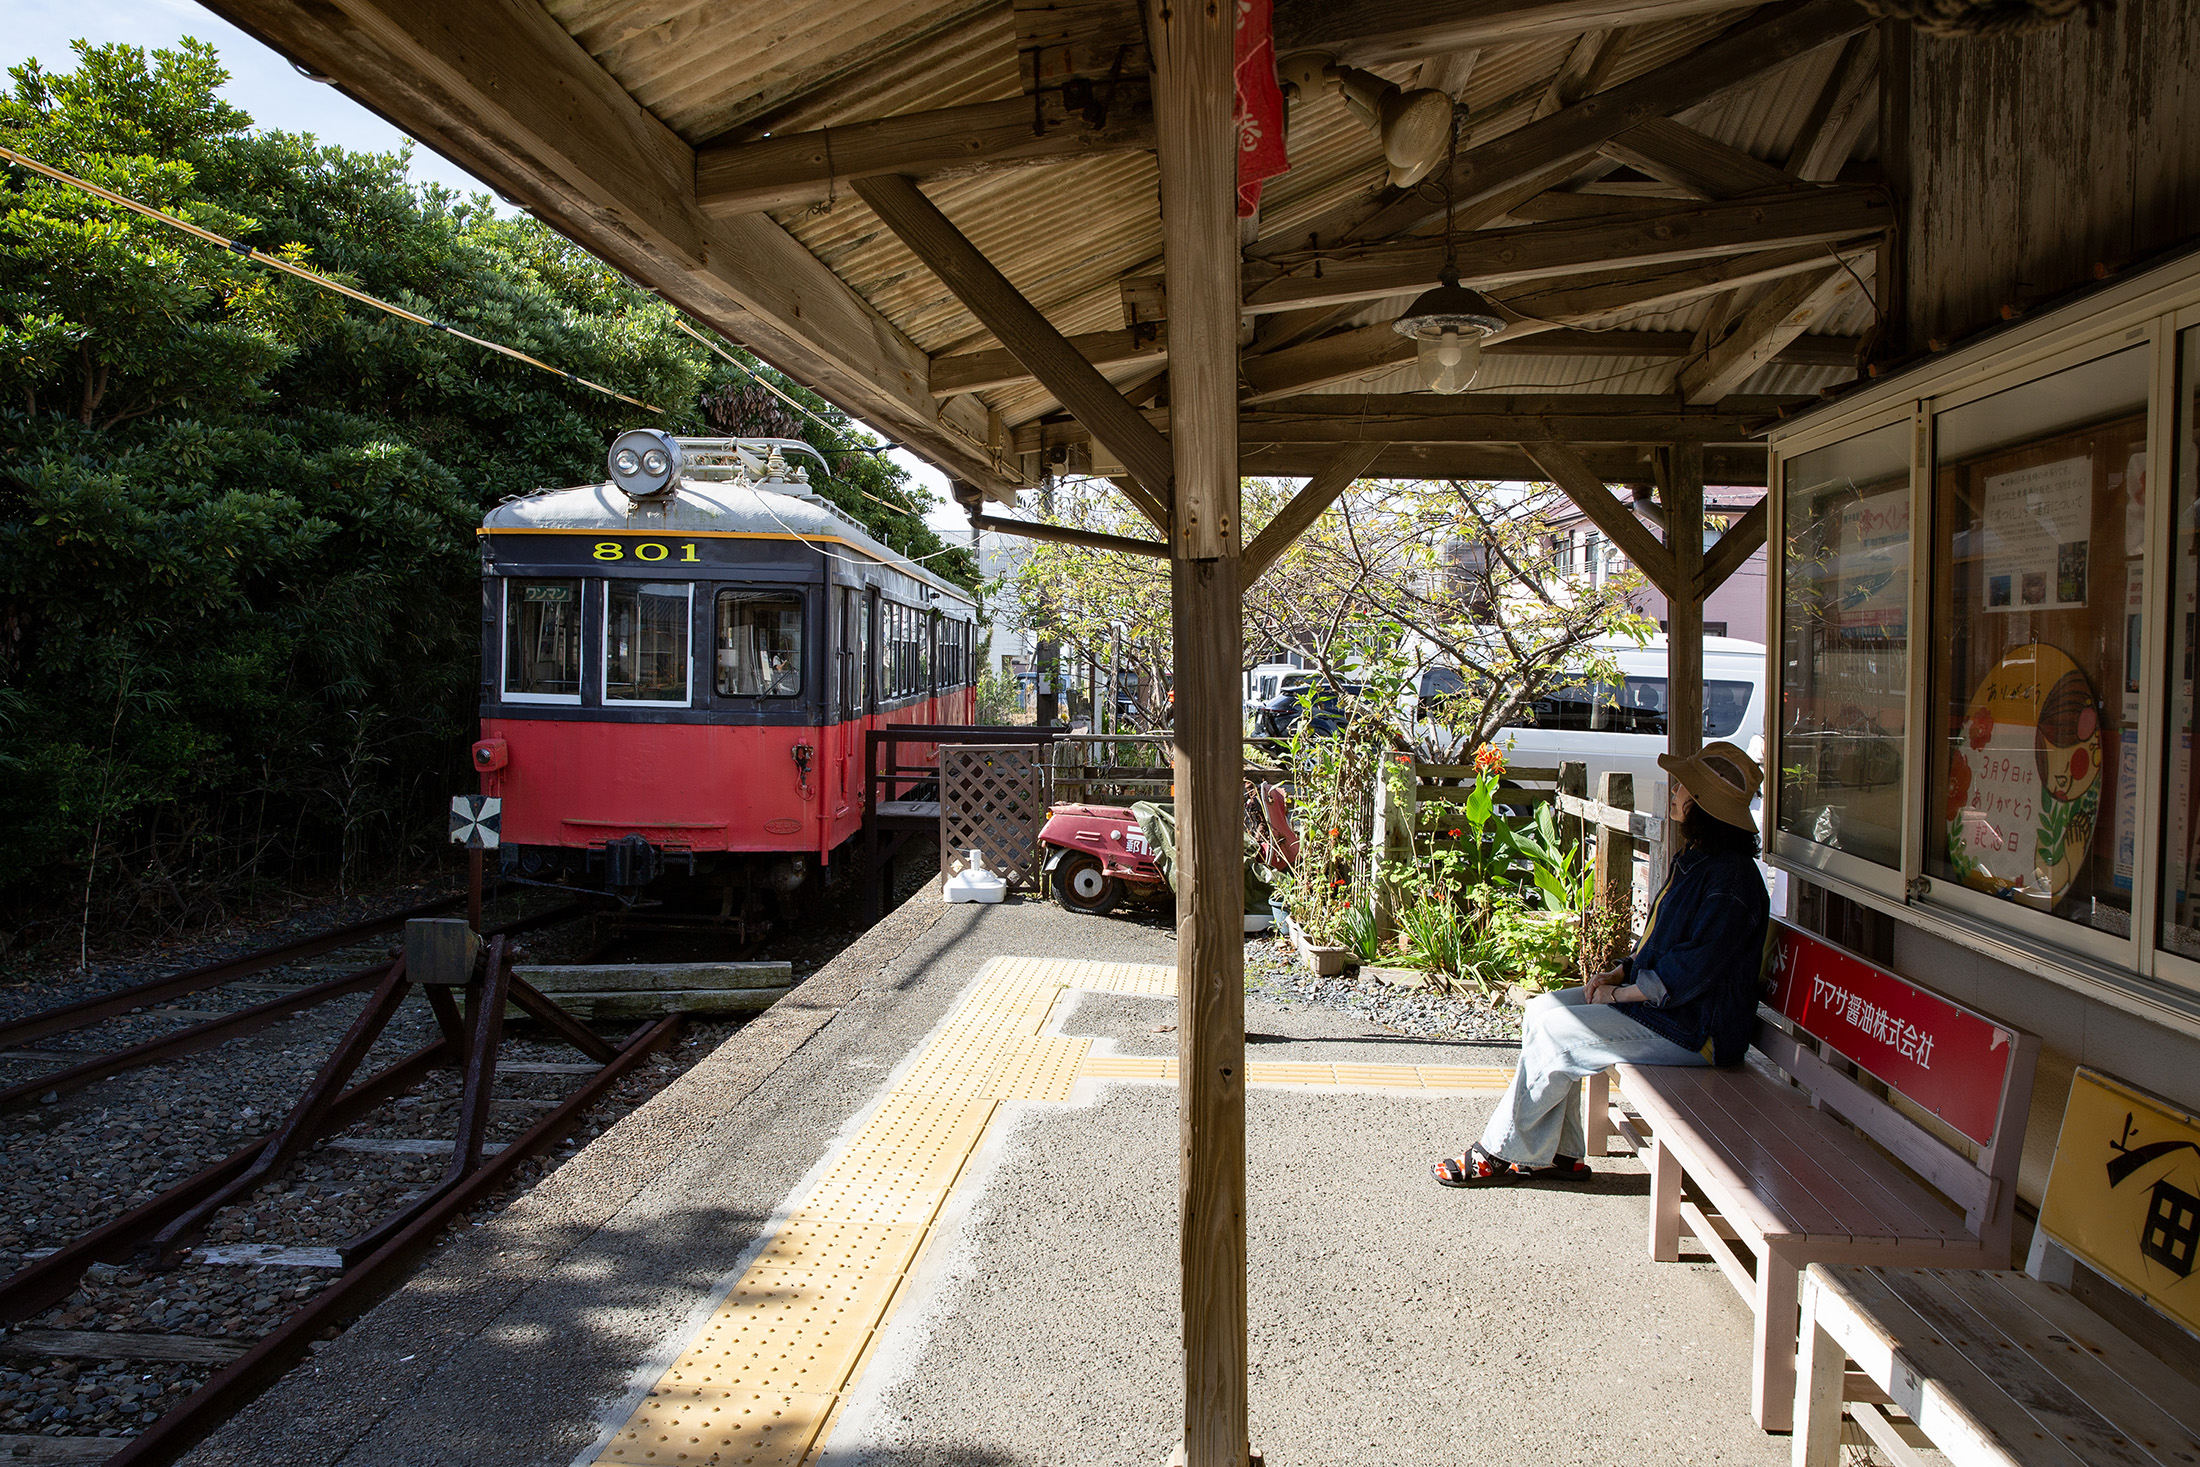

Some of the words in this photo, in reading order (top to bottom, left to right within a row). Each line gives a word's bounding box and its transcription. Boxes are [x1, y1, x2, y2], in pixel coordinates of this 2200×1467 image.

[592, 541, 702, 563] 801
[525, 586, 568, 601] ワンマン
[1987, 682, 2041, 706] ありがとう
[1981, 755, 2033, 784] 3月9日は
[1971, 788, 2032, 821] ありがとう
[1974, 823, 2019, 853] 記念日
[1812, 973, 1936, 1070] ヤマサ醤油株式会社
